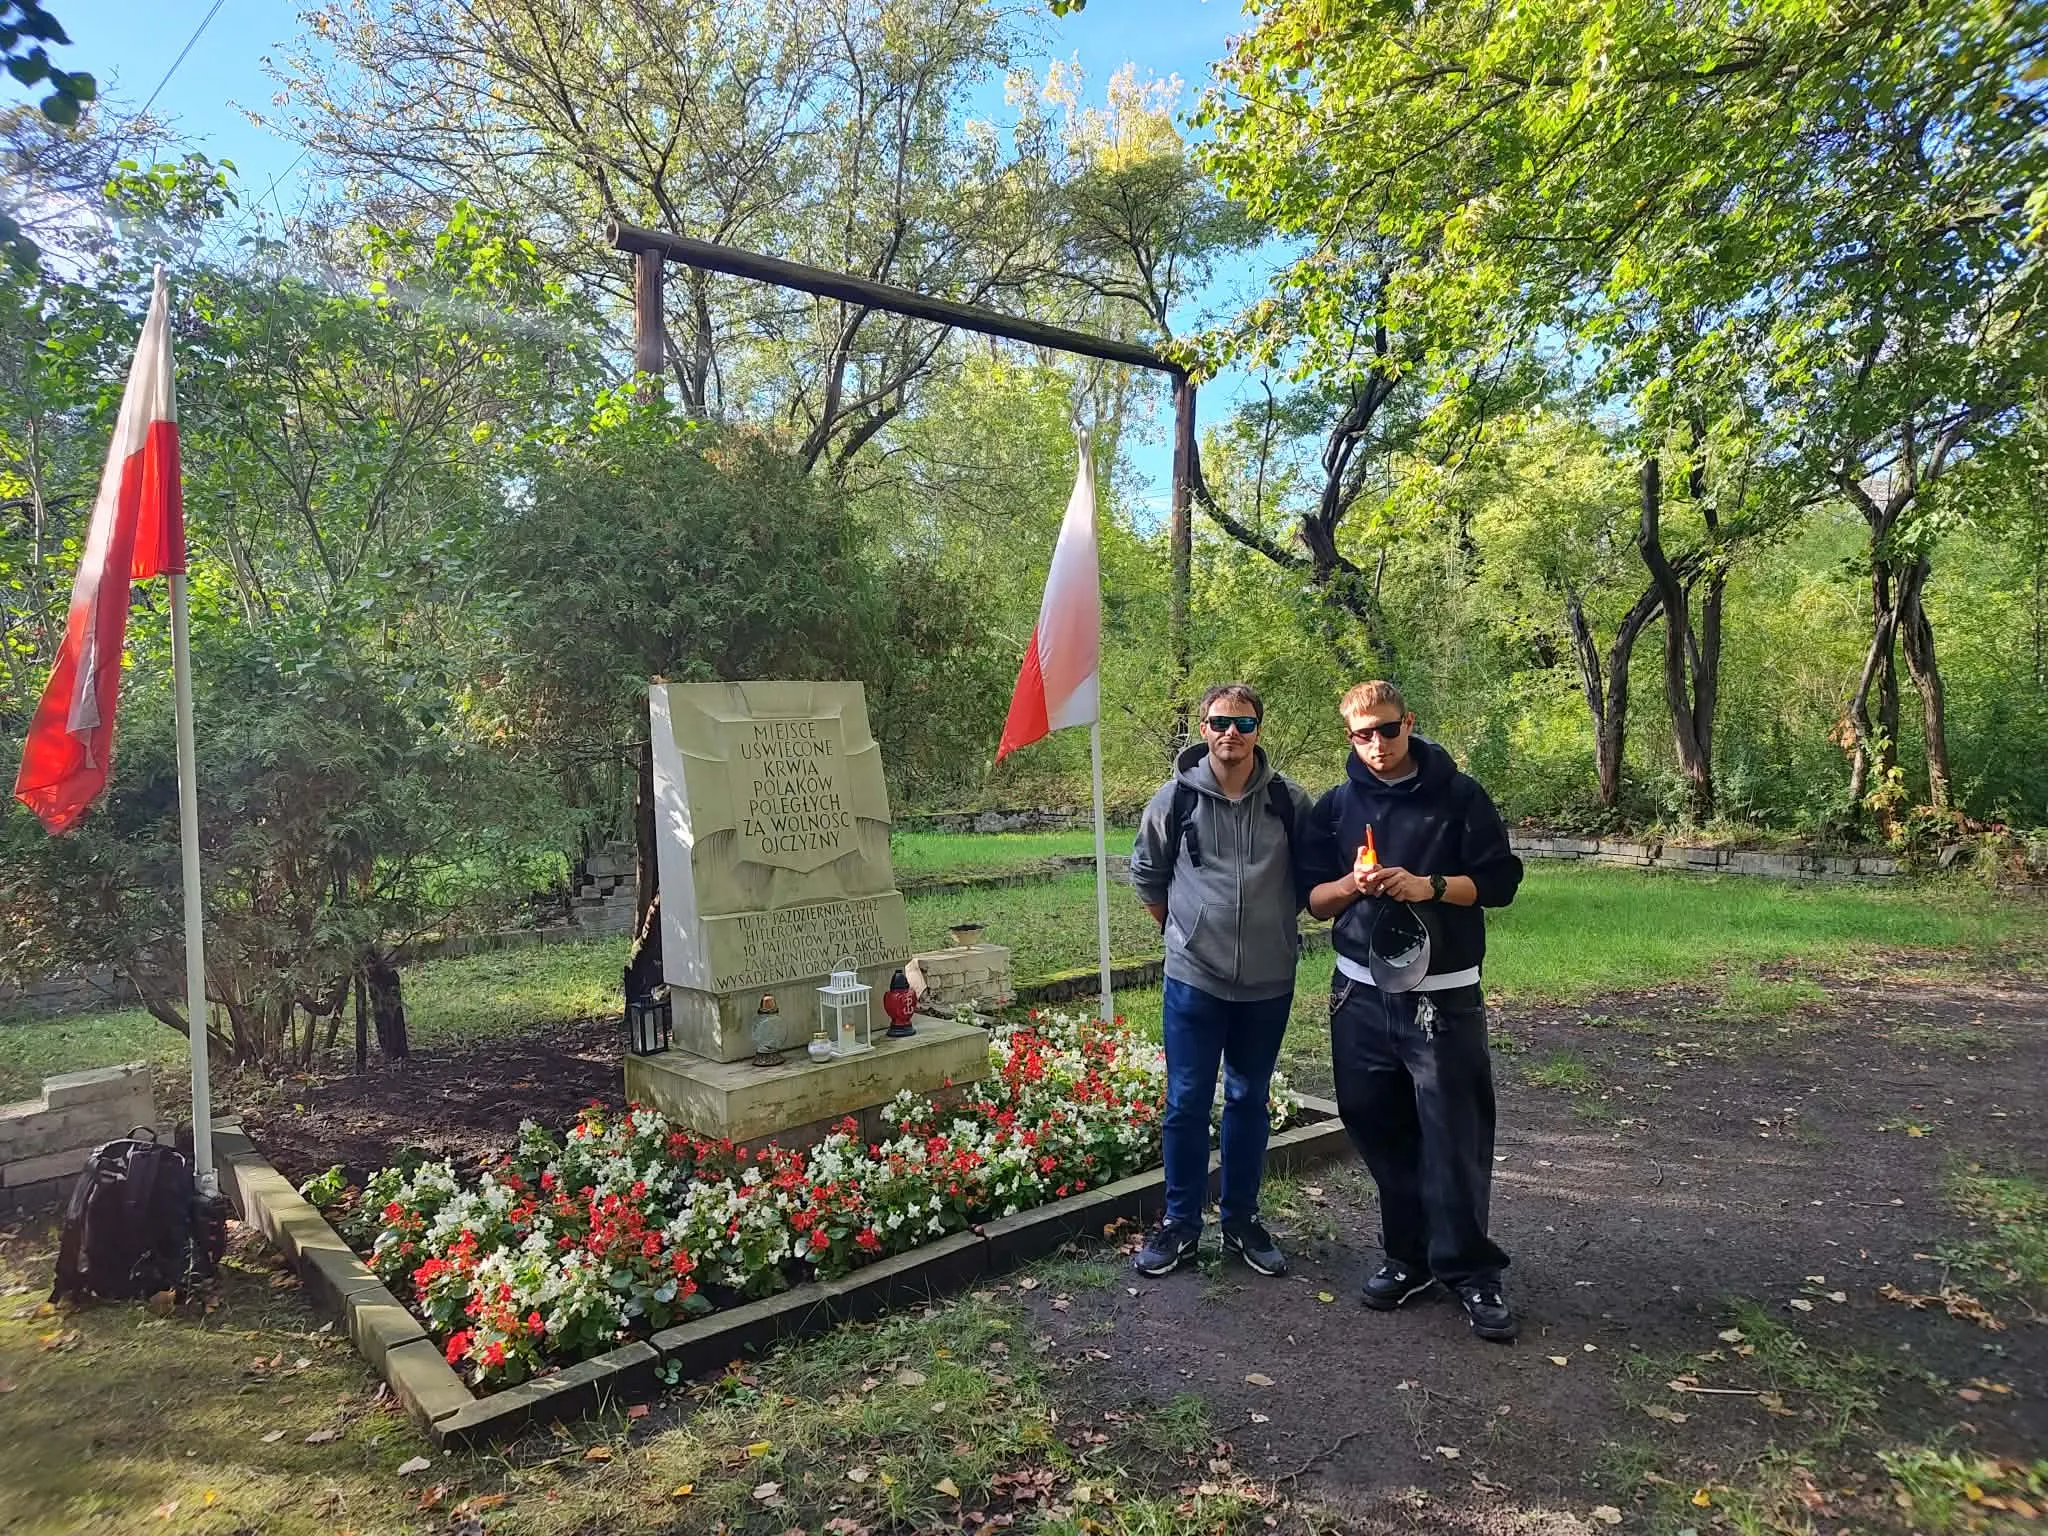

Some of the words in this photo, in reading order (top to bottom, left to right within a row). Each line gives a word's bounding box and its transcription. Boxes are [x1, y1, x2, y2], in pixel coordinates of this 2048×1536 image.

[754, 722, 816, 740] MIEJSCE
[743, 819, 765, 836] ZA
[761, 830, 840, 855] OJCZYZNY
[737, 916, 751, 930] TU
[834, 943, 850, 957] ZA
